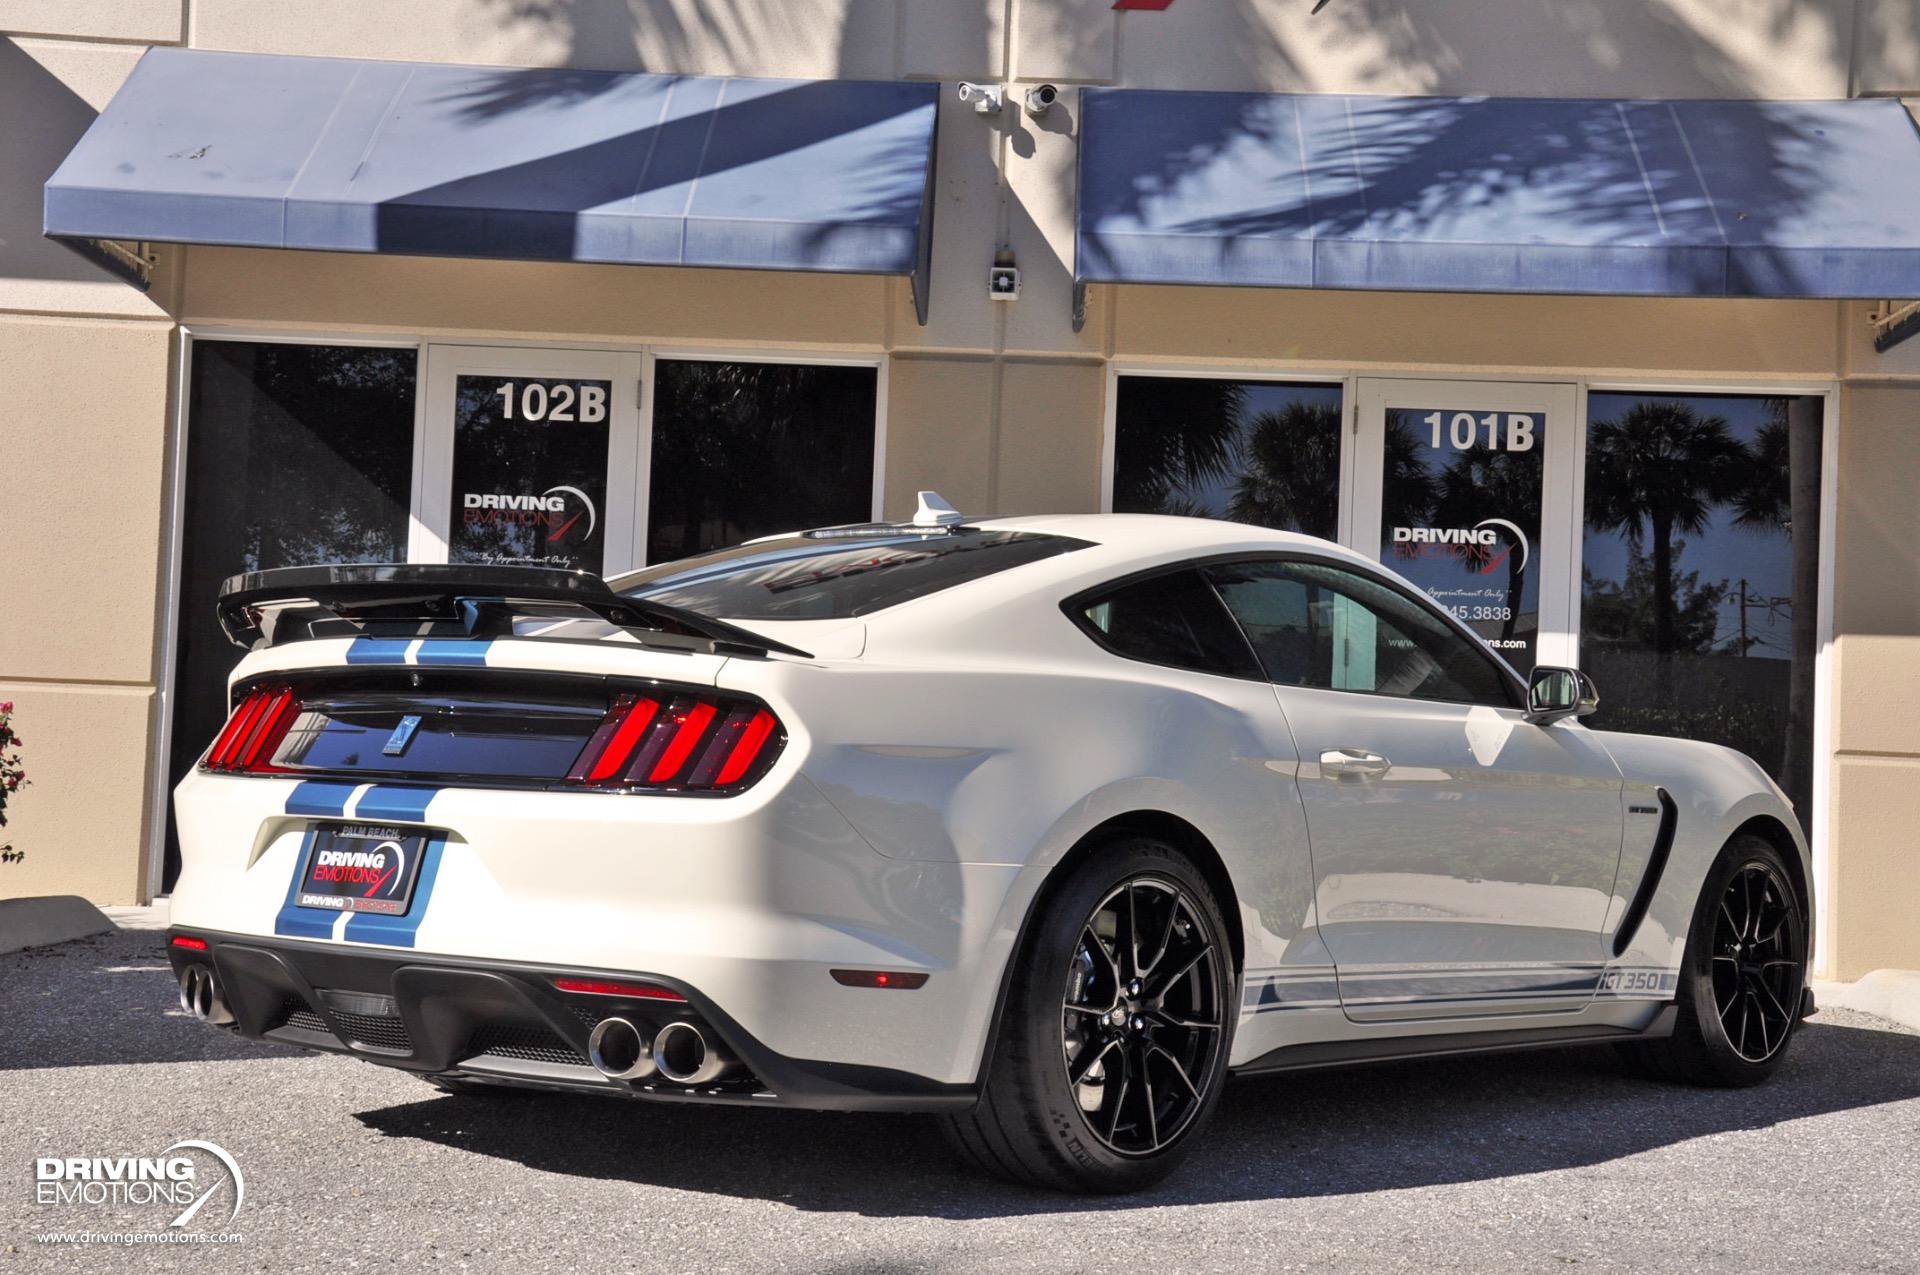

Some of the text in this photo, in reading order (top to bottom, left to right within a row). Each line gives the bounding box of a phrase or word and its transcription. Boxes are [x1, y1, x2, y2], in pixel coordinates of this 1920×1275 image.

[496, 382, 607, 423] 102B
[1424, 411, 1535, 452] 101B
[464, 493, 565, 512] DRIVING
[463, 509, 564, 528] EMOTIONS
[1393, 527, 1497, 546] DRIVING
[317, 850, 386, 869] DRIVING
[313, 865, 382, 884] EMOTIONS
[302, 894, 344, 907] DRIVING
[1624, 972, 1659, 990] 350
